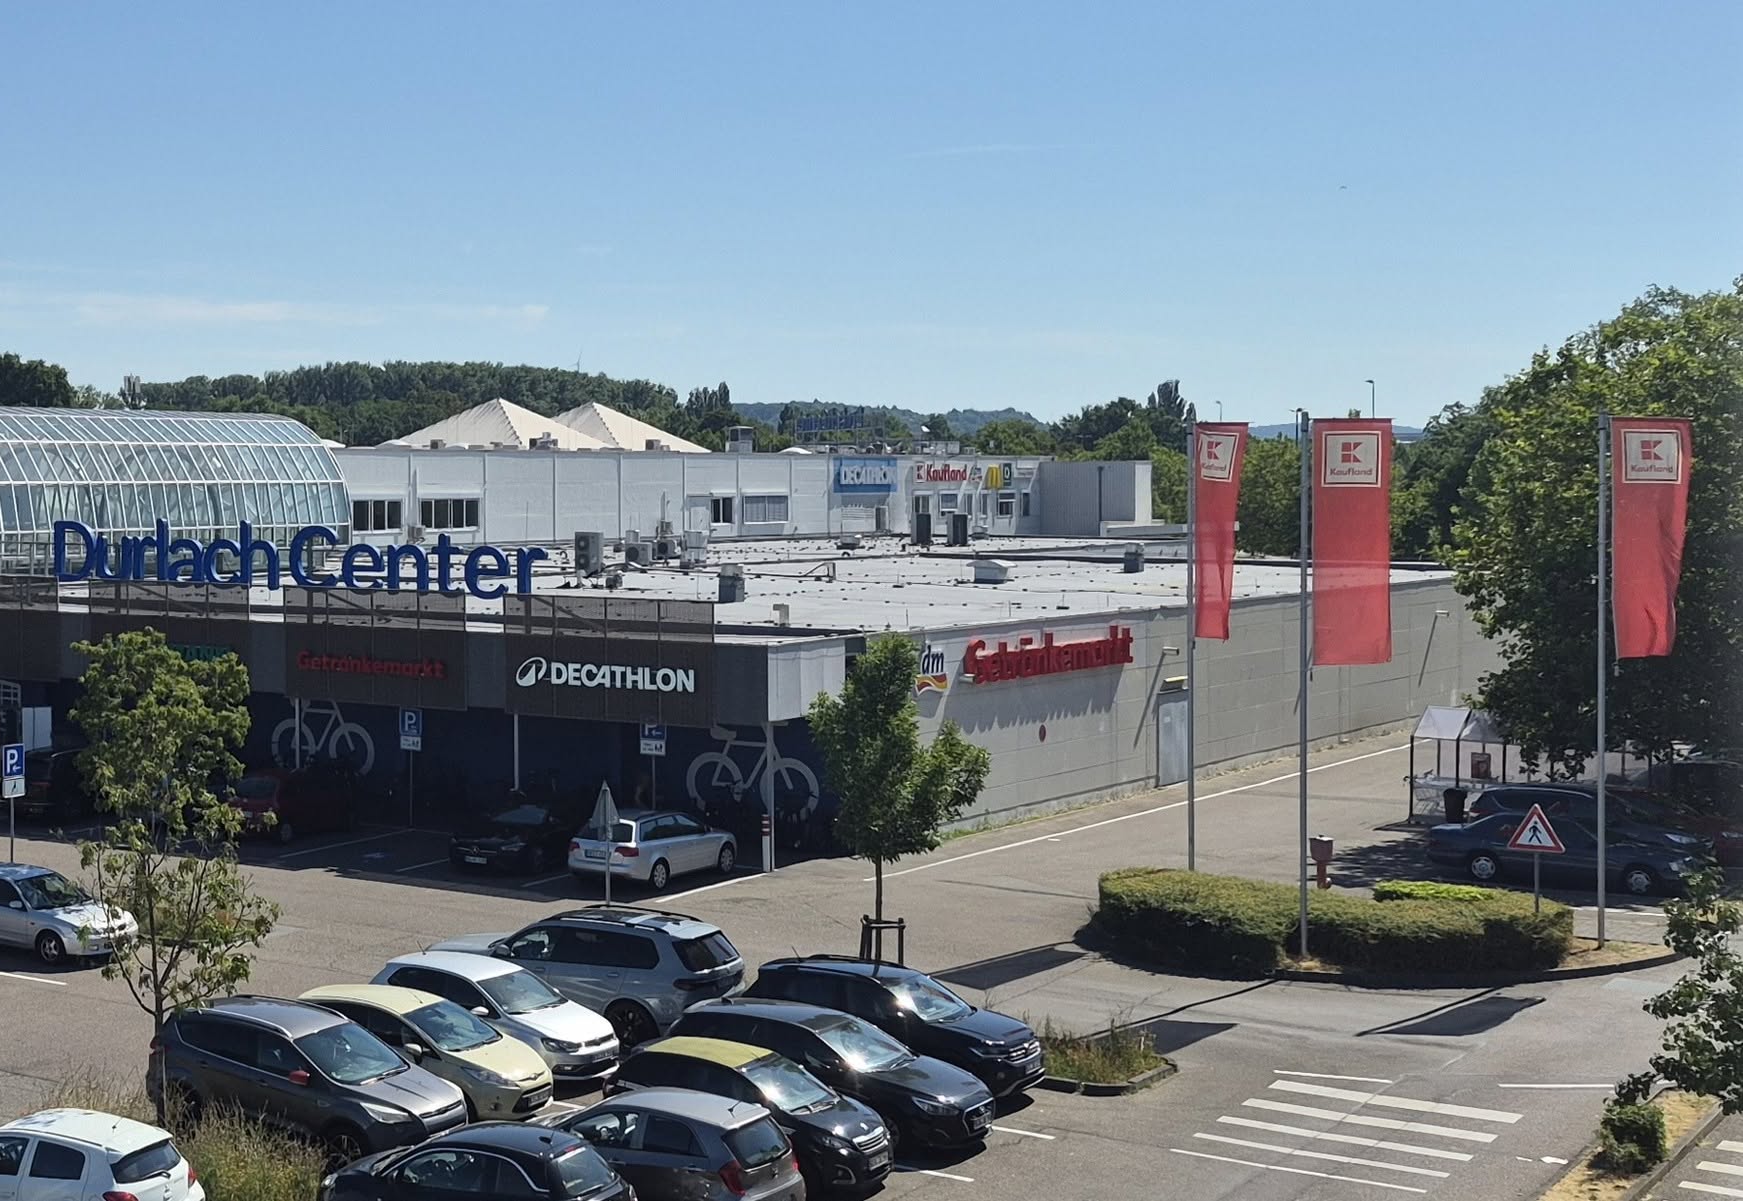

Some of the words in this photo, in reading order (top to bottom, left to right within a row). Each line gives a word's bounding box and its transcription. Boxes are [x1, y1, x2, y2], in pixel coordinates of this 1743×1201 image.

[839, 464, 897, 486] DECATHLON
[926, 463, 968, 482] Kaufland
[1329, 467, 1374, 477] Kaufland
[1630, 464, 1674, 474] Kaufland
[54, 517, 280, 591] Durlach
[289, 525, 549, 600] Center
[296, 650, 447, 680] Getränkemarkt
[921, 644, 945, 675] dm
[964, 625, 1134, 685] Getränkemarkt
[550, 661, 696, 693] DECATHLON
[404, 711, 417, 731] P
[6, 749, 19, 774] P
